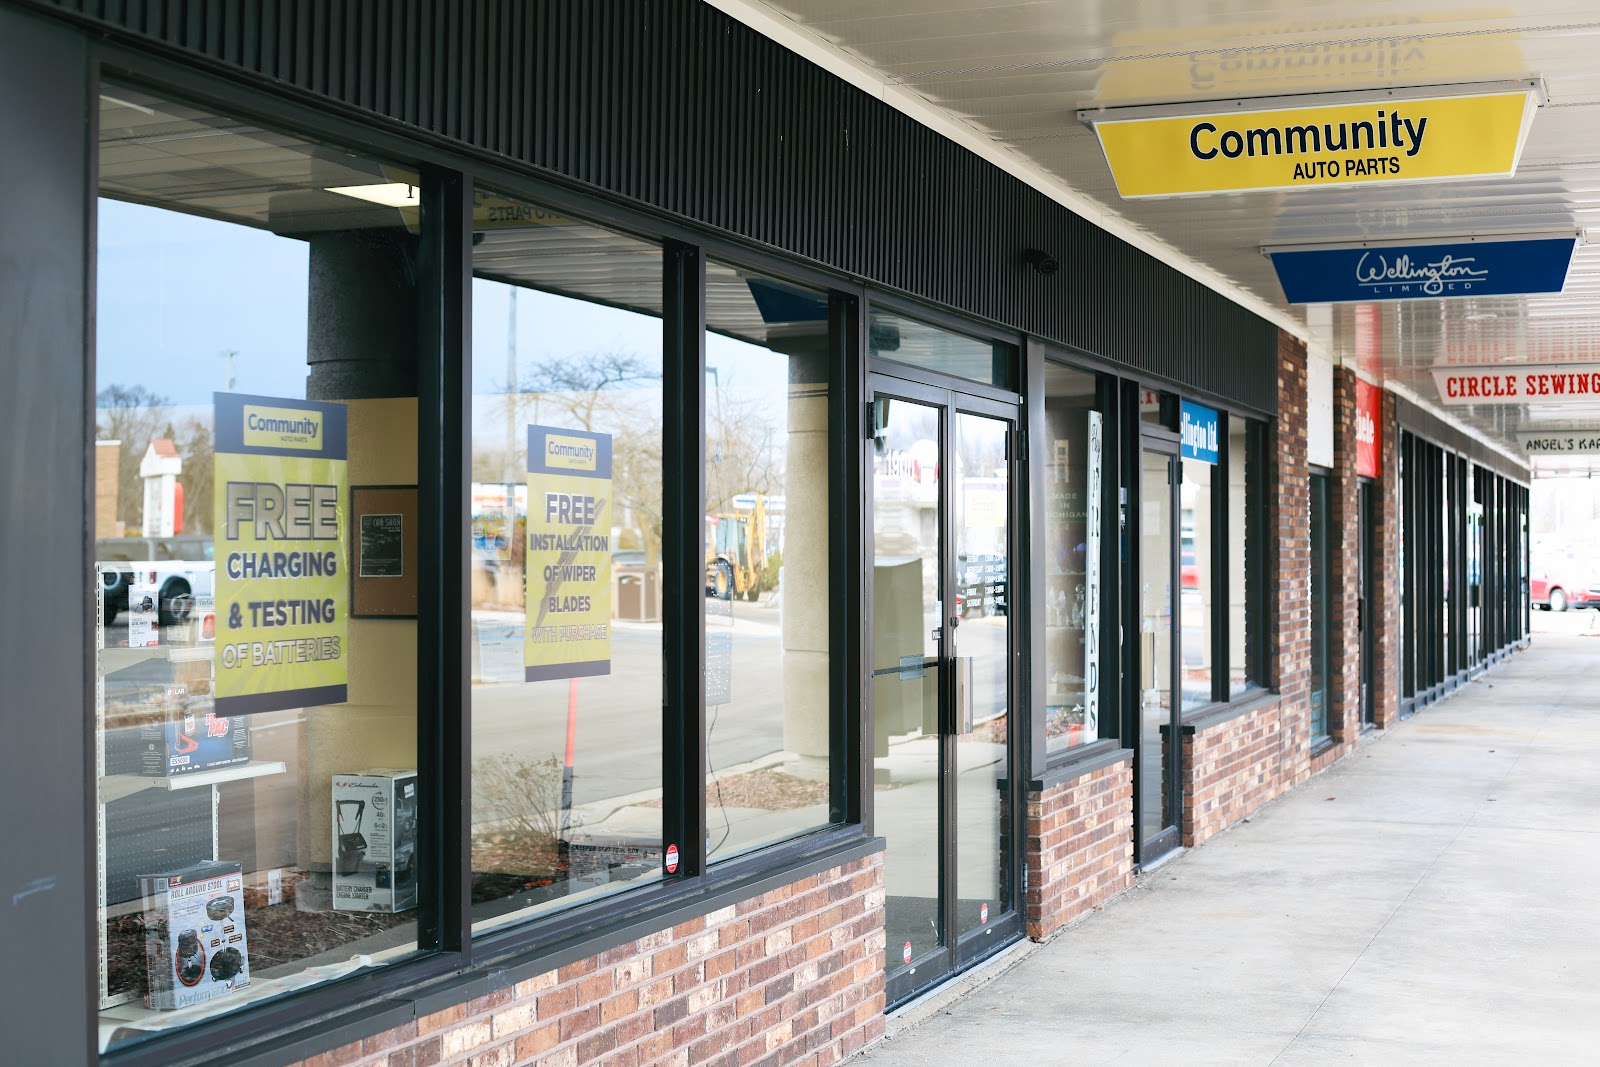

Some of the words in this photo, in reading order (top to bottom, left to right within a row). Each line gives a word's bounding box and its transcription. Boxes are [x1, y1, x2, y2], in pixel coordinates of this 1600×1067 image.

[1189, 110, 1428, 161] Community
[1293, 160, 1340, 180] AUTO
[1346, 157, 1400, 177] PARTS
[1356, 251, 1489, 295] Wellington
[1373, 282, 1472, 294] LIMITED
[1446, 376, 1517, 398] CIRCLE
[1526, 373, 1600, 396] SEWING
[248, 413, 319, 438] Community
[1207, 421, 1218, 452] Ltd.
[1355, 408, 1375, 444] iele
[548, 440, 594, 461] Community
[1526, 438, 1574, 451] ANGEL'S
[226, 481, 338, 540] FREE
[545, 493, 595, 525] FREE
[530, 533, 608, 552] INSTALLATION
[227, 551, 337, 579] CHARGING
[543, 565, 561, 582] OF
[562, 565, 596, 582] WIPER
[549, 595, 591, 614] BLADES
[1089, 467, 1100, 732] FRENDS
[228, 602, 243, 629] &
[248, 598, 335, 628] TESTING
[531, 626, 557, 643] WITH
[560, 624, 608, 642] PURCHASE
[222, 643, 248, 669] OF
[252, 636, 341, 667] BATTERIES
[208, 720, 229, 737] PAC
[171, 888, 185, 899] ROLL
[185, 884, 206, 896] AROUND
[207, 880, 223, 892] STOOL
[336, 885, 353, 893] BATTERY
[353, 886, 372, 894] CHARGER
